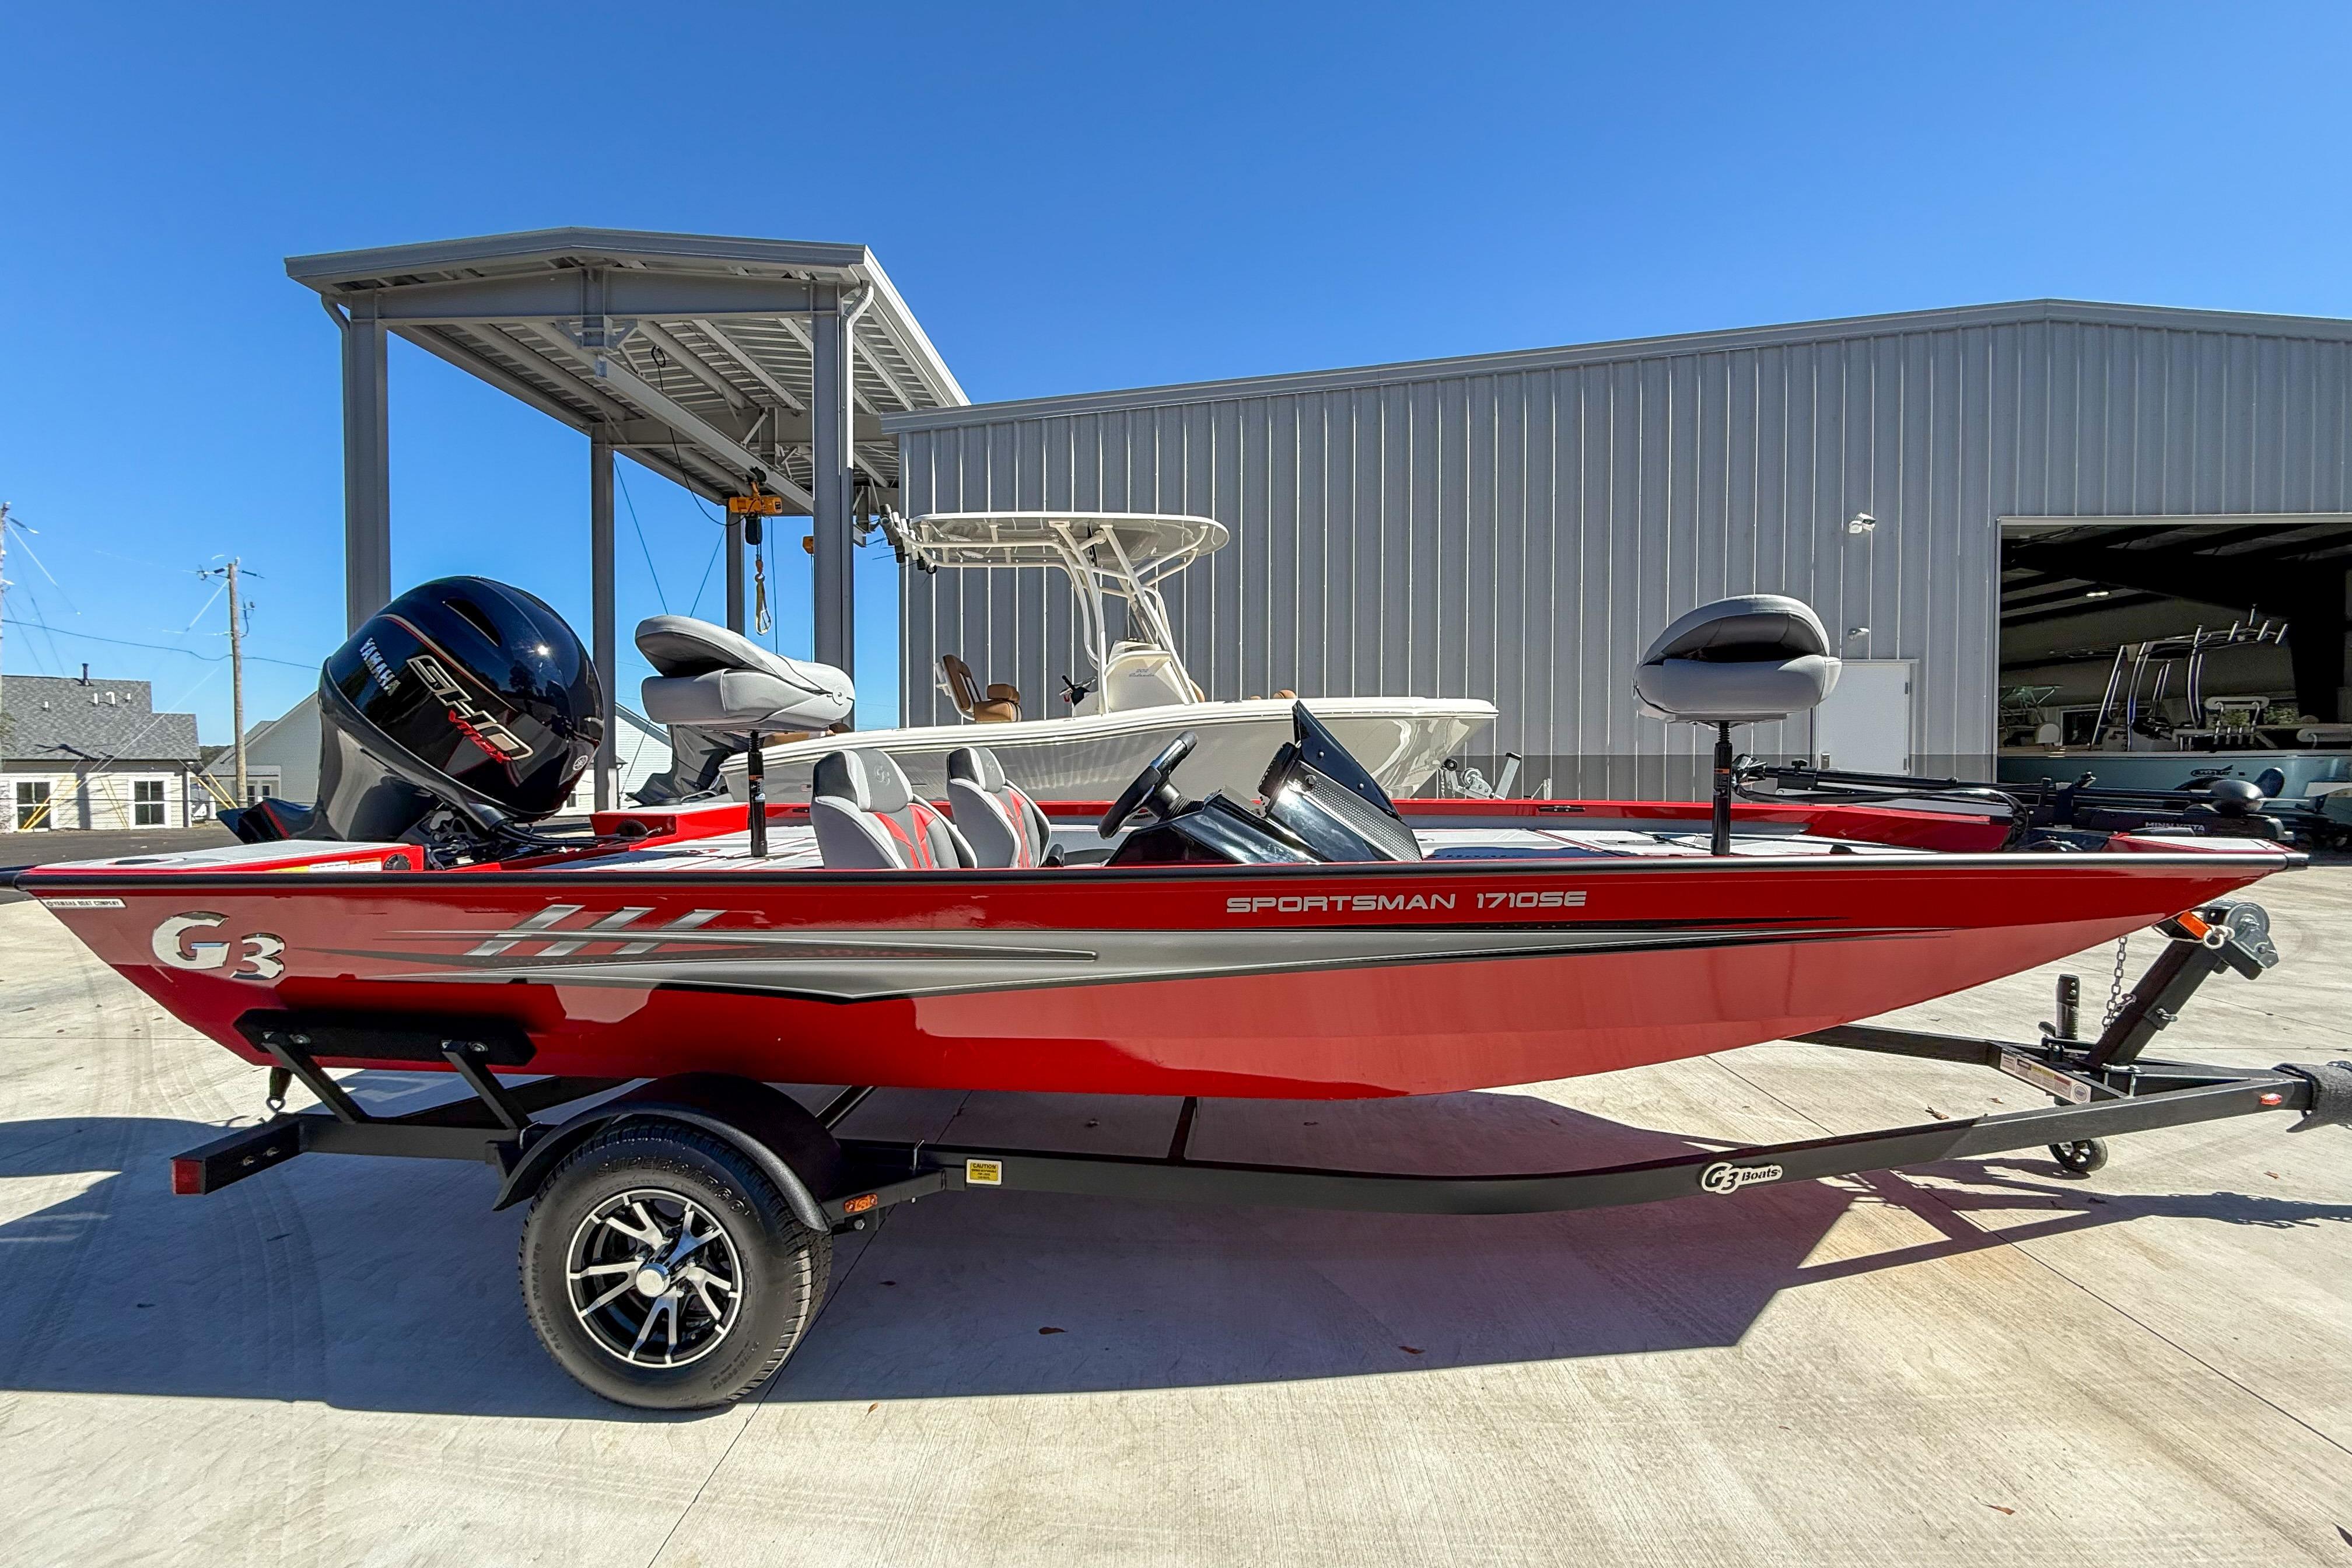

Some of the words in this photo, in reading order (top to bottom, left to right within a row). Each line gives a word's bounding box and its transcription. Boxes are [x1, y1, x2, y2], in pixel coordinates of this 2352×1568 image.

[359, 638, 401, 696] YAMAHA
[407, 654, 534, 761] SHO
[1226, 894, 1456, 913] SPORTSMAN
[1476, 891, 1587, 908] 1710SE
[152, 911, 286, 981] G3
[596, 1156, 745, 1213] SUPERCARGO
[1704, 1165, 1740, 1191] G3
[1742, 1168, 1779, 1182] Boats
